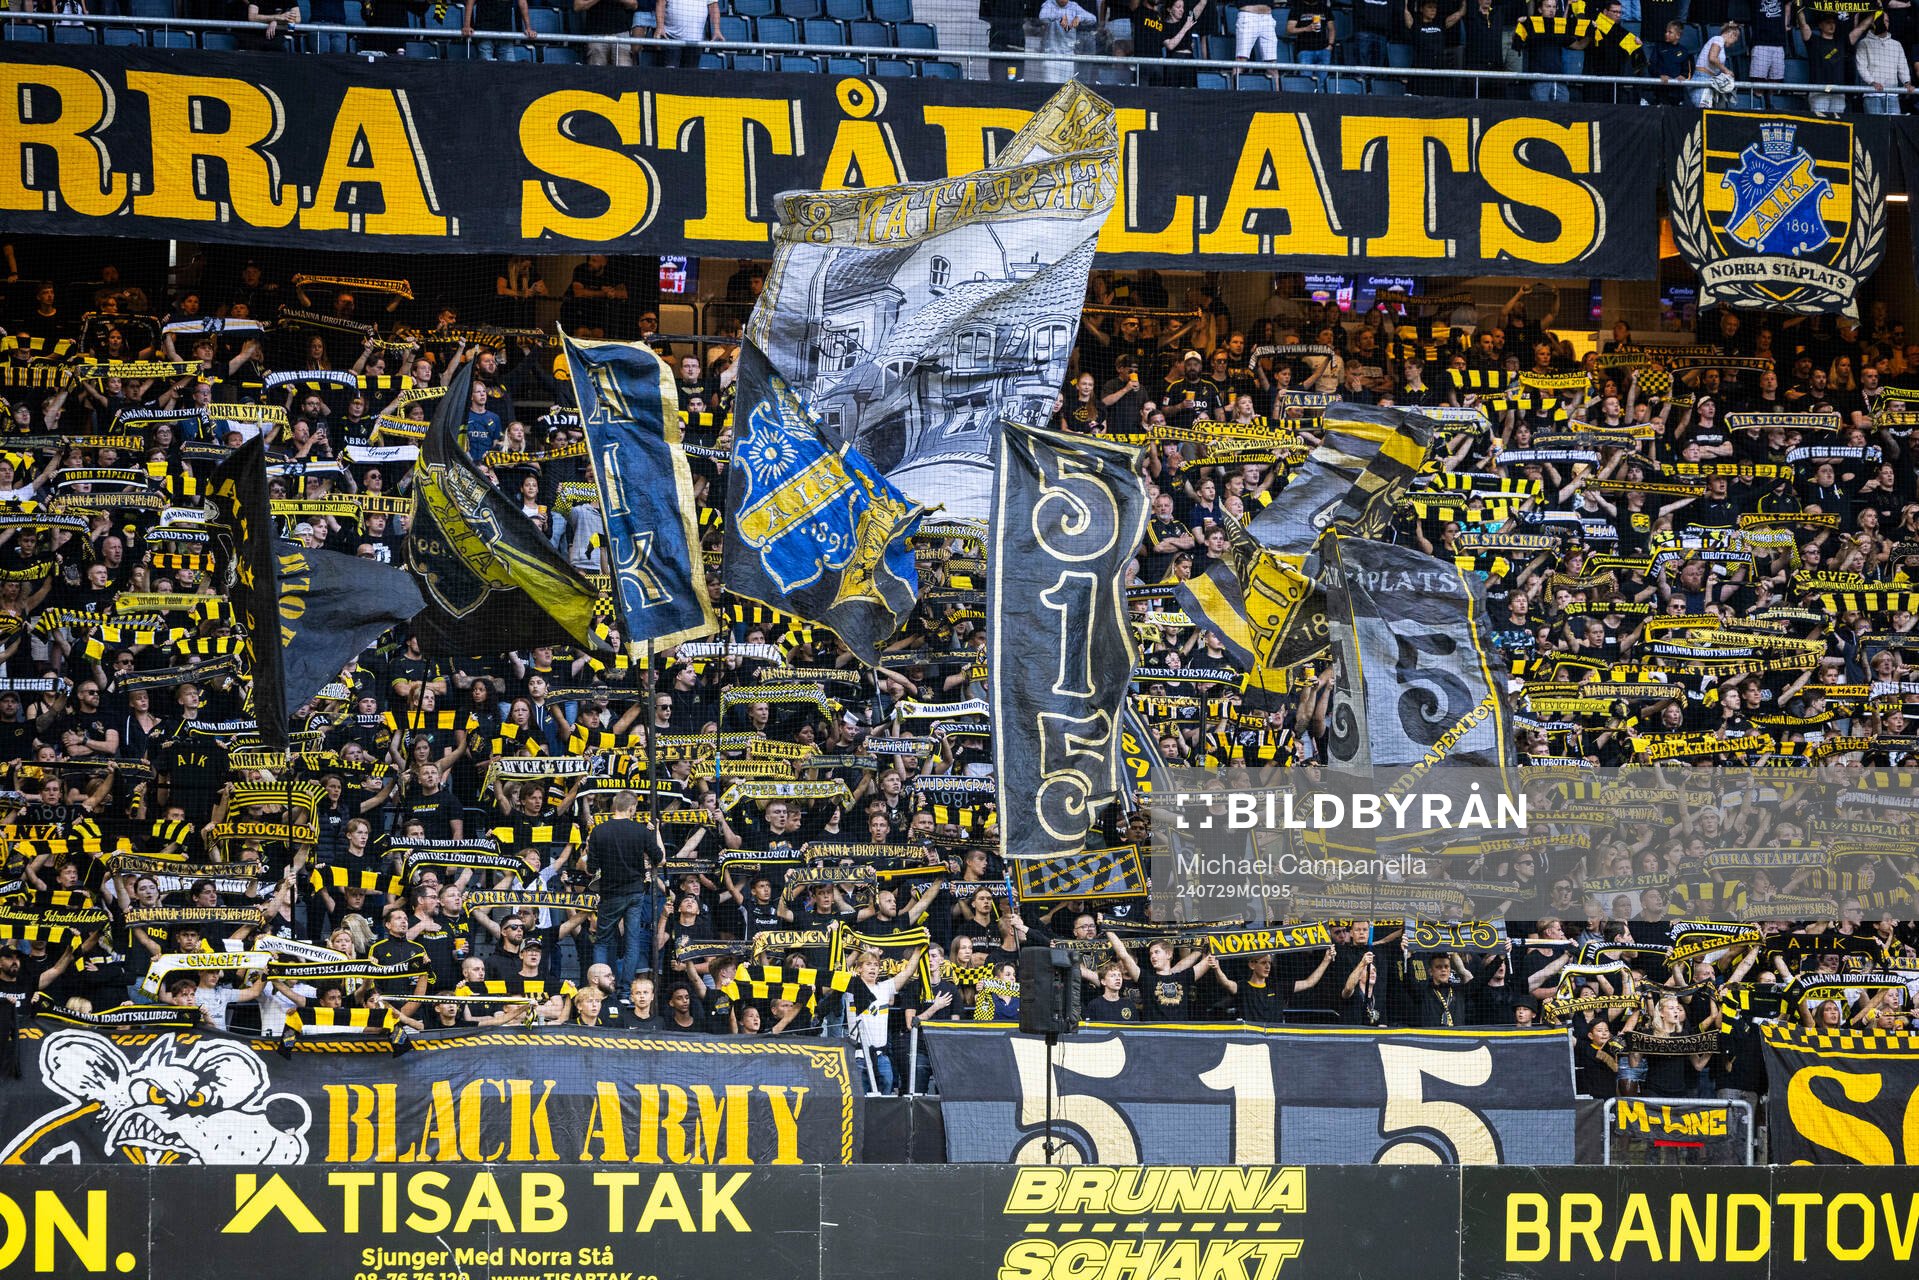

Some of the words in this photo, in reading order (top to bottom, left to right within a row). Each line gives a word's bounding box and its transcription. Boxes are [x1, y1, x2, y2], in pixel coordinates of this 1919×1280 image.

[1369, 277, 1391, 285] Combo
[1393, 277, 1415, 287] Deals
[1710, 264, 1767, 279] NORRA
[1773, 263, 1848, 290] STÅPLATS
[1732, 416, 1753, 427] AIK
[1757, 416, 1838, 427] STOCKHOLM
[65, 470, 92, 481] NORRA
[97, 469, 136, 481] STÅPLATS
[1614, 602, 1650, 613] SOLNA
[1711, 634, 1749, 646] NORRA
[1653, 644, 1693, 656] ALLMÄNNA
[1134, 667, 1175, 677] STADENS
[596, 778, 627, 790] NORRA
[1753, 850, 1828, 867] STÅPLATS
[1208, 932, 1290, 957] NORRA
[1293, 919, 1331, 945] STÅ
[186, 953, 245, 968] GNAGET
[100, 1010, 179, 1022] IDROTTSKLUBBEN
[322, 1079, 560, 1164] BLACK
[585, 1081, 810, 1165] ARMY
[1003, 1166, 1307, 1214] BRUNNA
[327, 1171, 569, 1234] TISAB
[592, 1172, 752, 1233] TAK
[361, 1247, 449, 1271] Sjunger
[454, 1247, 504, 1267] Med
[508, 1247, 573, 1267] Norra
[578, 1244, 614, 1267] Stå
[997, 1238, 1305, 1280] SCHAKT
